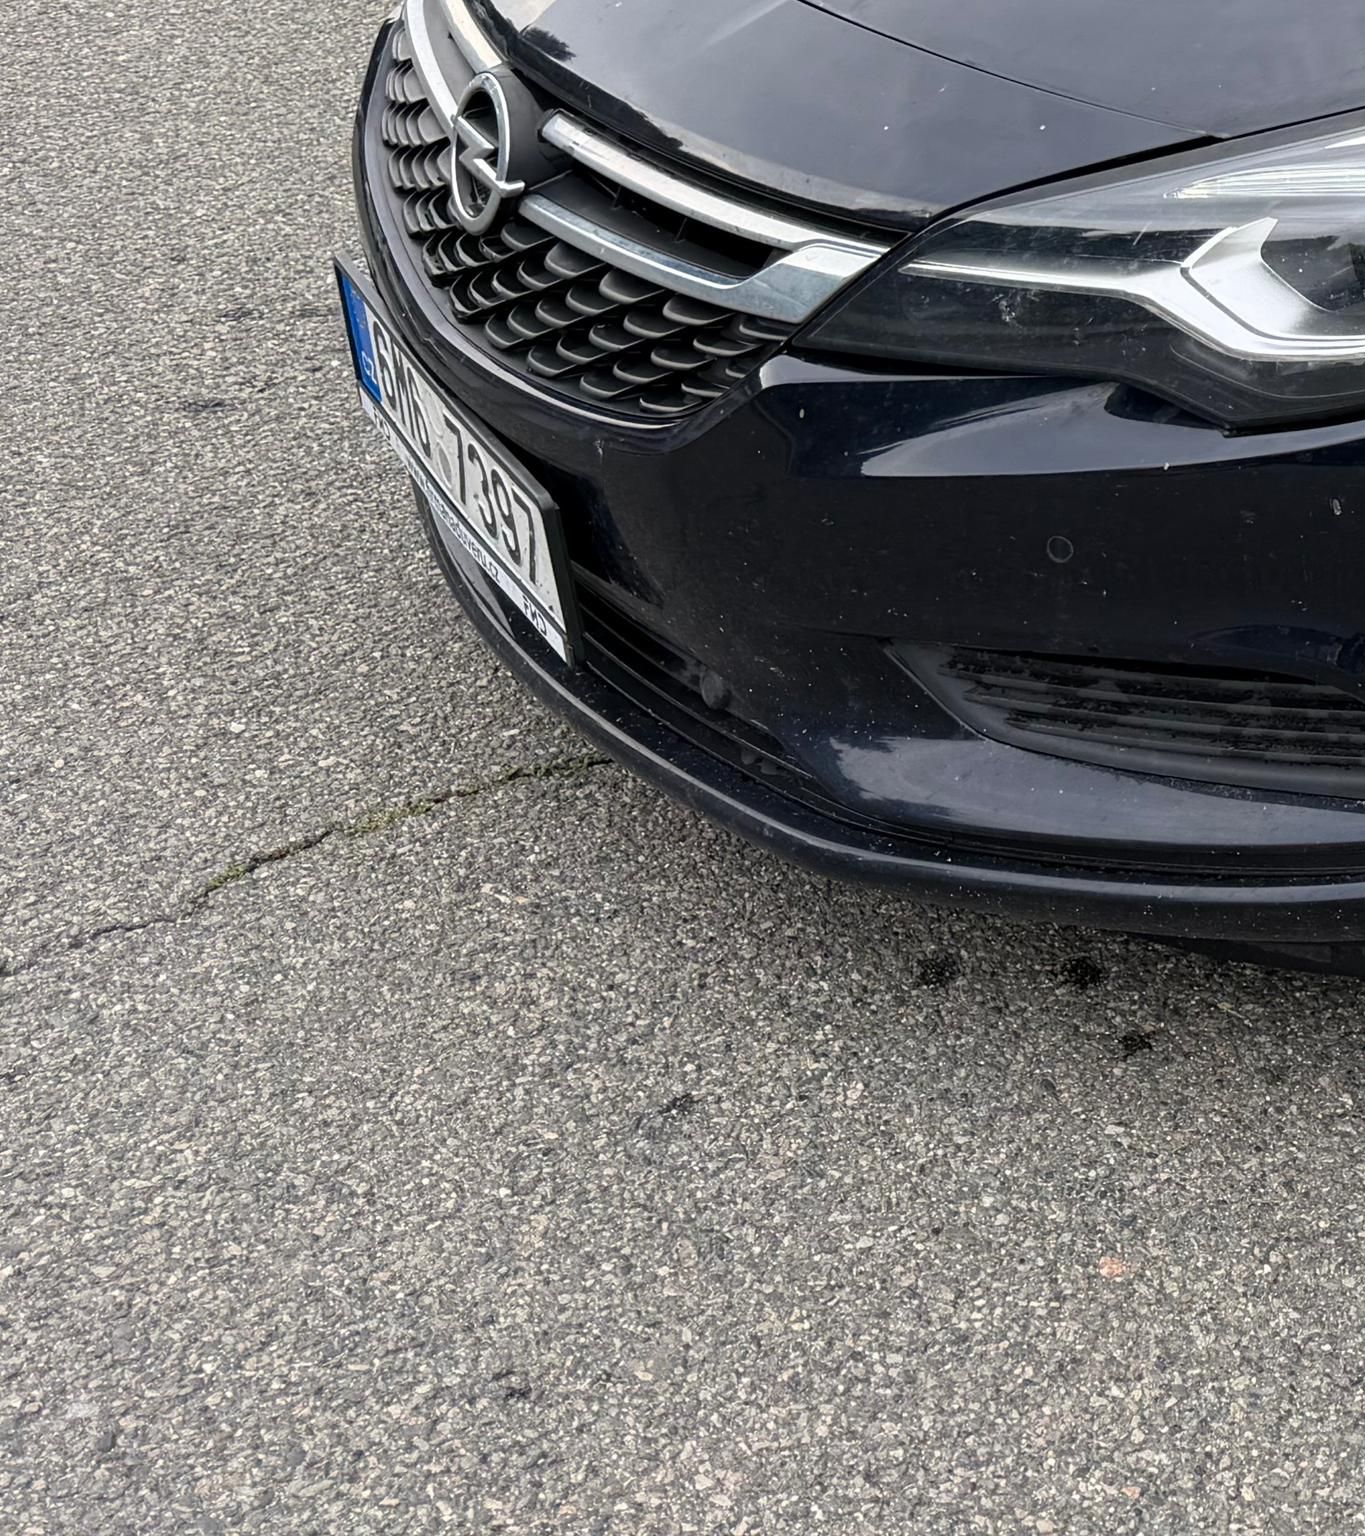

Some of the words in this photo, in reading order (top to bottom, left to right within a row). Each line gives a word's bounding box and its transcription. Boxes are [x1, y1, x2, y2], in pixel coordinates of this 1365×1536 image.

[361, 351, 378, 385] CZ
[373, 321, 431, 459] 6M6
[443, 413, 537, 586] 7397
